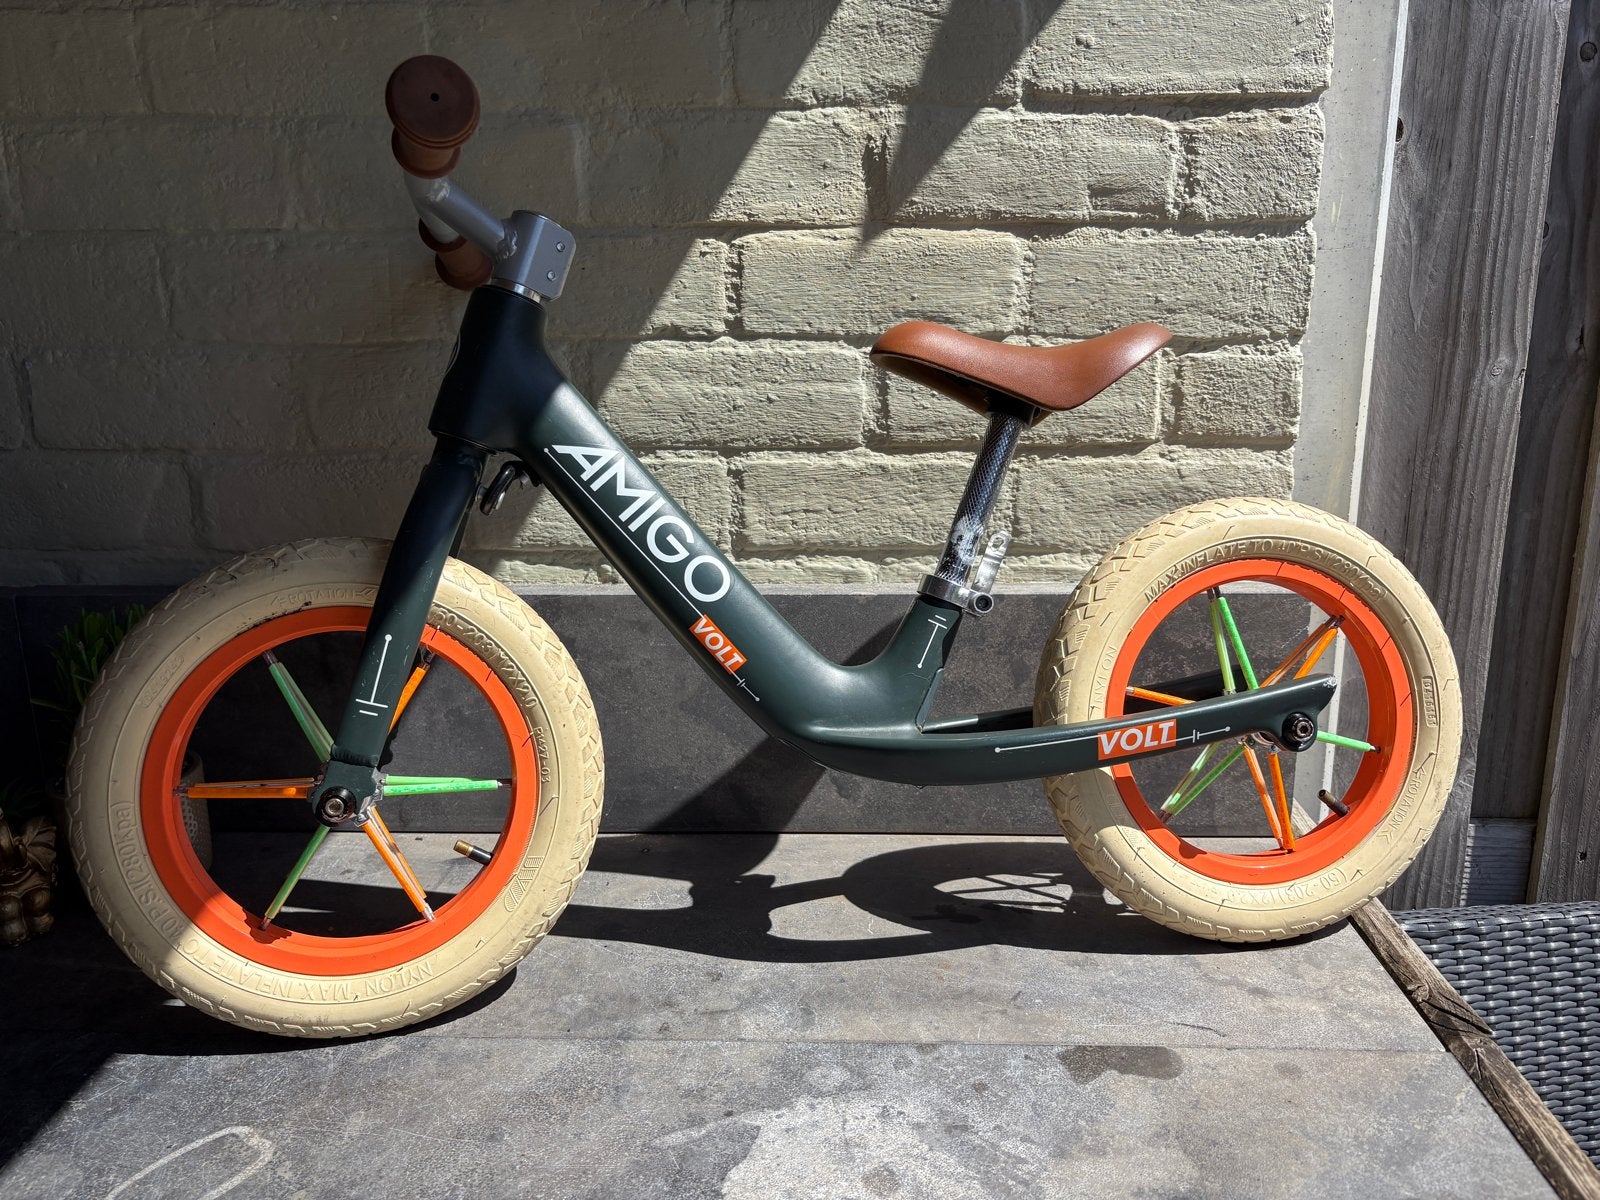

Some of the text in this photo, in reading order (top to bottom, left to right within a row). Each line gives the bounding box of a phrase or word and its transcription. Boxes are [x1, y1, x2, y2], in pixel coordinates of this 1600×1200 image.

[552, 444, 731, 602] AMIGO
[1178, 542, 1246, 574] INFLATE
[1250, 539, 1274, 552] TO
[288, 588, 357, 604] ROTATION
[693, 616, 743, 672] VOLT
[1100, 721, 1175, 755] VOLT
[1388, 779, 1421, 830] ROTATION
[181, 938, 209, 967] TO
[209, 955, 298, 1000] INFLATE
[364, 960, 433, 997] NYLON
